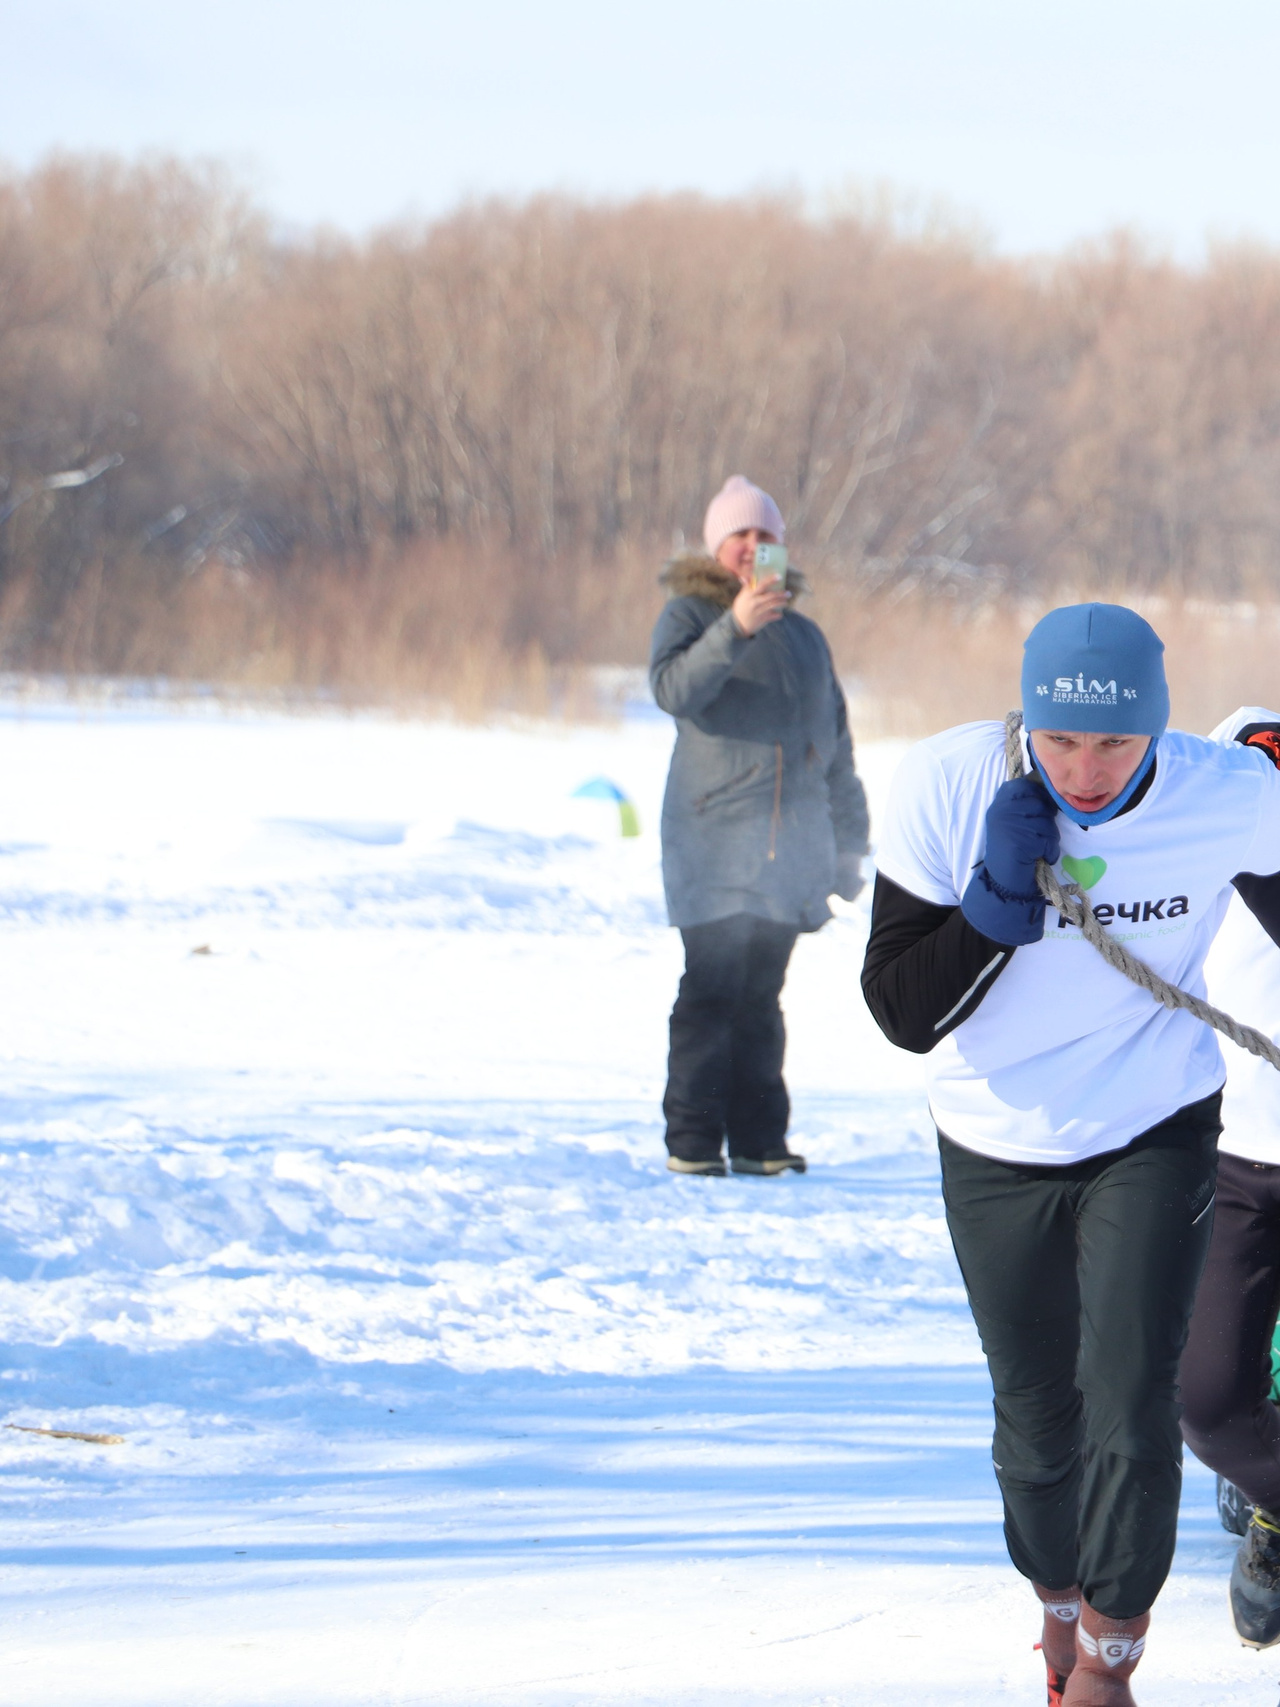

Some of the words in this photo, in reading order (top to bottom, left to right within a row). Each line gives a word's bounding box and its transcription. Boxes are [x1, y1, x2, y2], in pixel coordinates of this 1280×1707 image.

[1053, 691, 1098, 700] SIBERIAN
[1157, 921, 1187, 937] food
[1056, 1607, 1074, 1618] G
[1106, 1645, 1122, 1657] G
